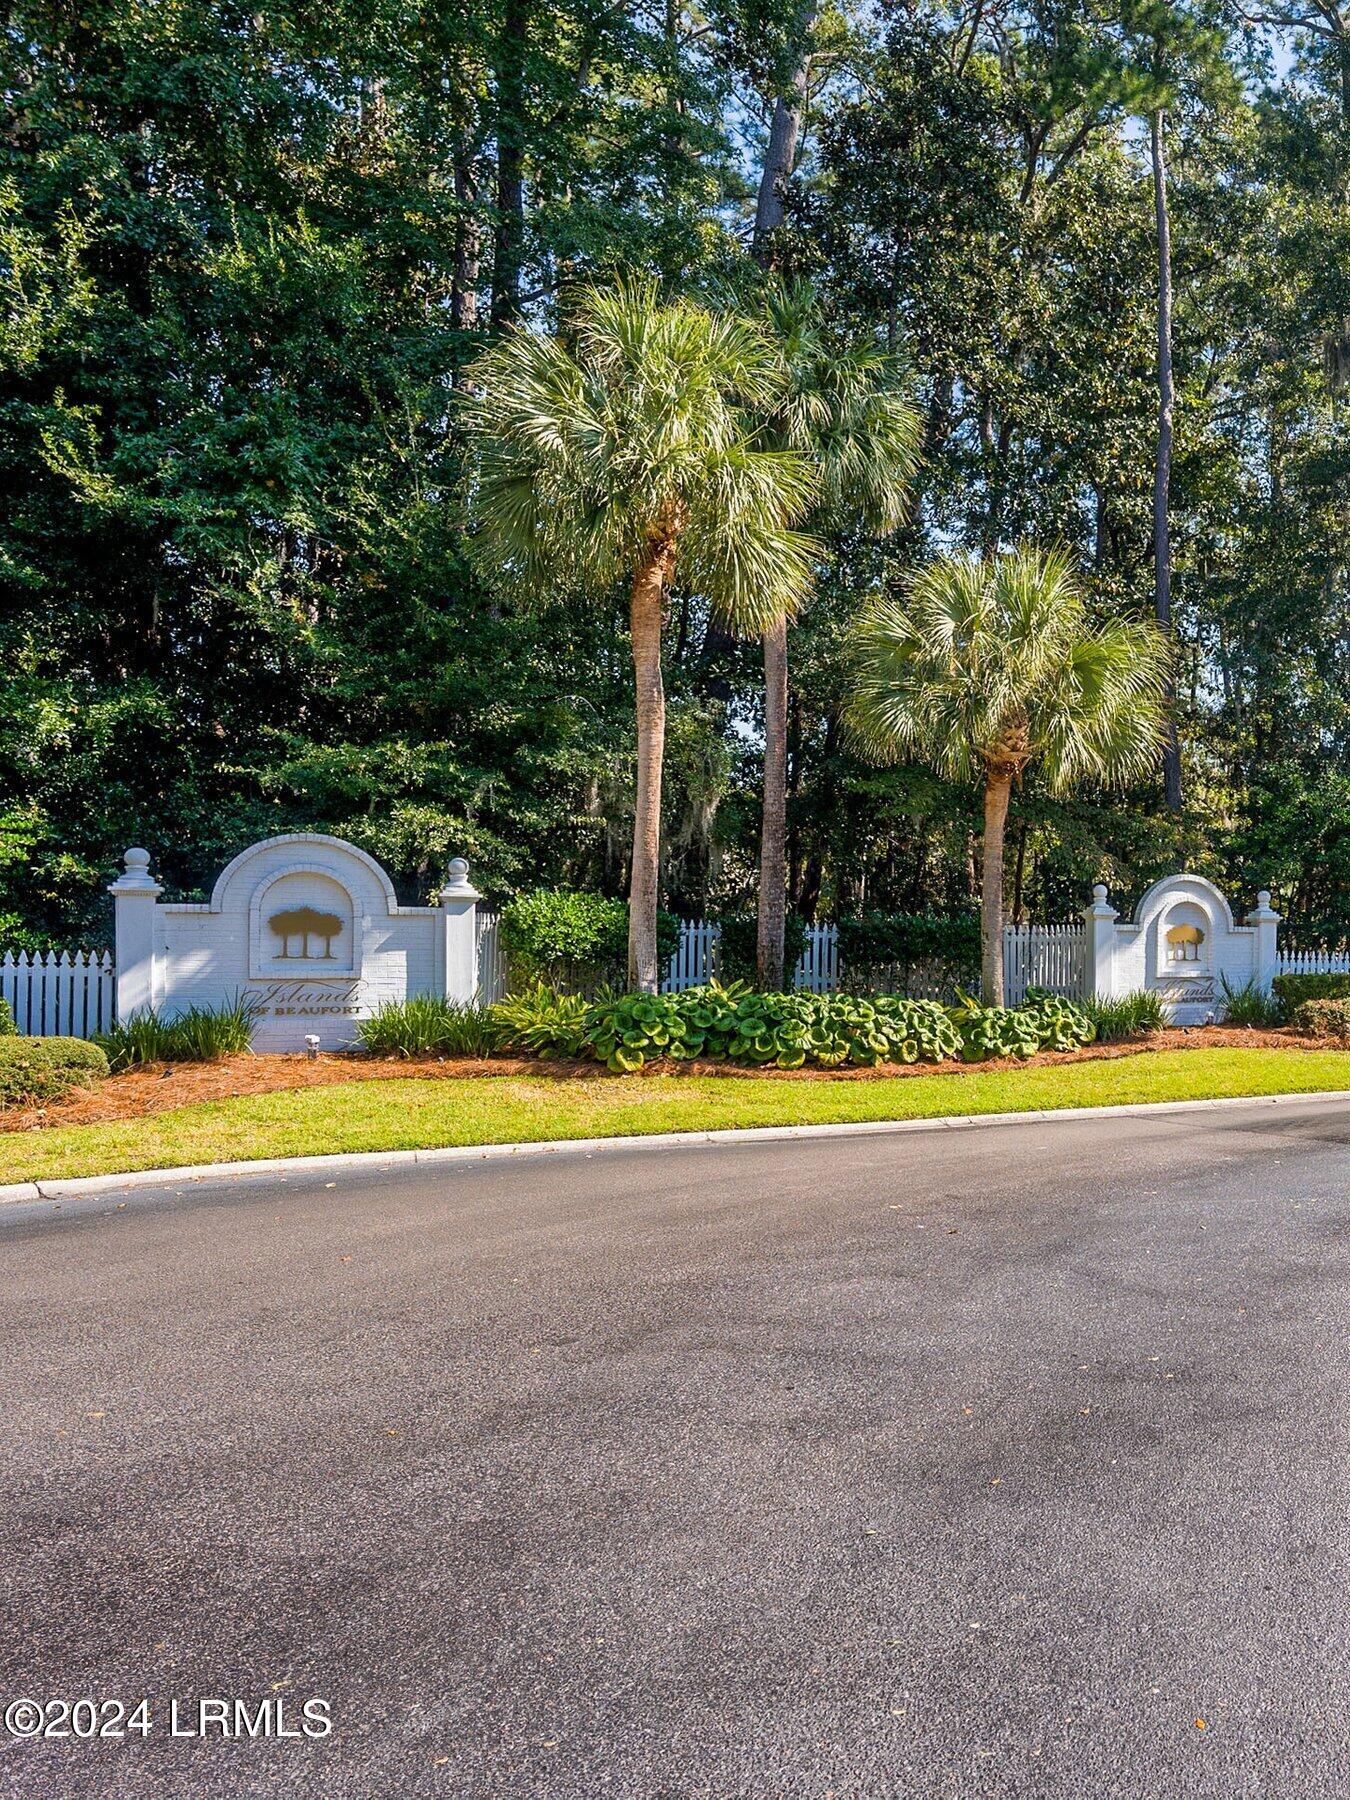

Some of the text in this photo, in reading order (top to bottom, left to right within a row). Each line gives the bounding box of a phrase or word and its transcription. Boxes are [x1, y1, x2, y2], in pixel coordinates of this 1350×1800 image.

[241, 980, 369, 1006] Islands
[249, 1006, 363, 1016] OF BEAUFORT
